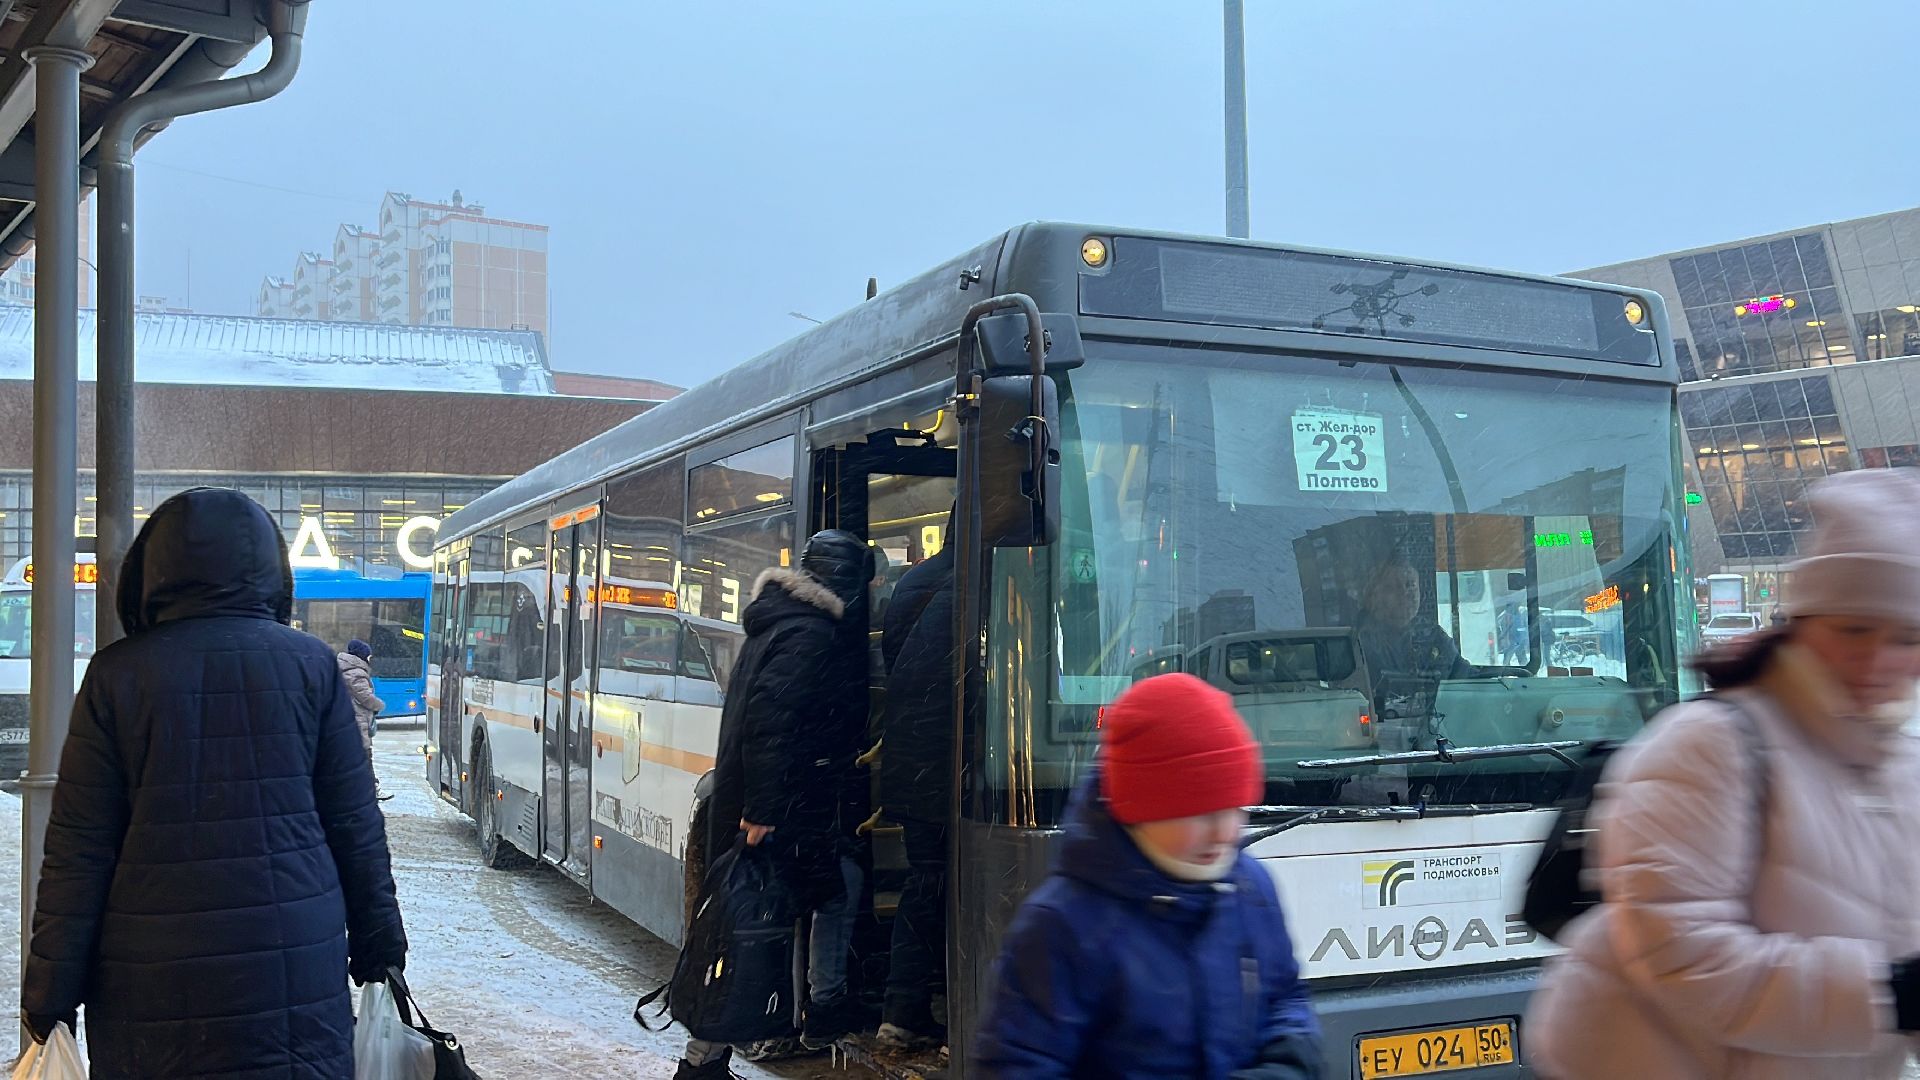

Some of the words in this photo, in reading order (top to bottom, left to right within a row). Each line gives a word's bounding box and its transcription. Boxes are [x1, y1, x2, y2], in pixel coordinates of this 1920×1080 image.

[1296, 423, 1316, 433] ст.
[1319, 421, 1377, 435] Жел-дор
[1312, 433, 1367, 472] 23
[1306, 473, 1379, 489] Полтево
[1423, 856, 1483, 868] ТРАНСПОРТ
[1423, 867, 1499, 880] ПОДМОСКОВЬЯ
[1417, 1034, 1465, 1068] 024
[1478, 1028, 1501, 1052] 50
[1483, 1053, 1501, 1063] RUS
